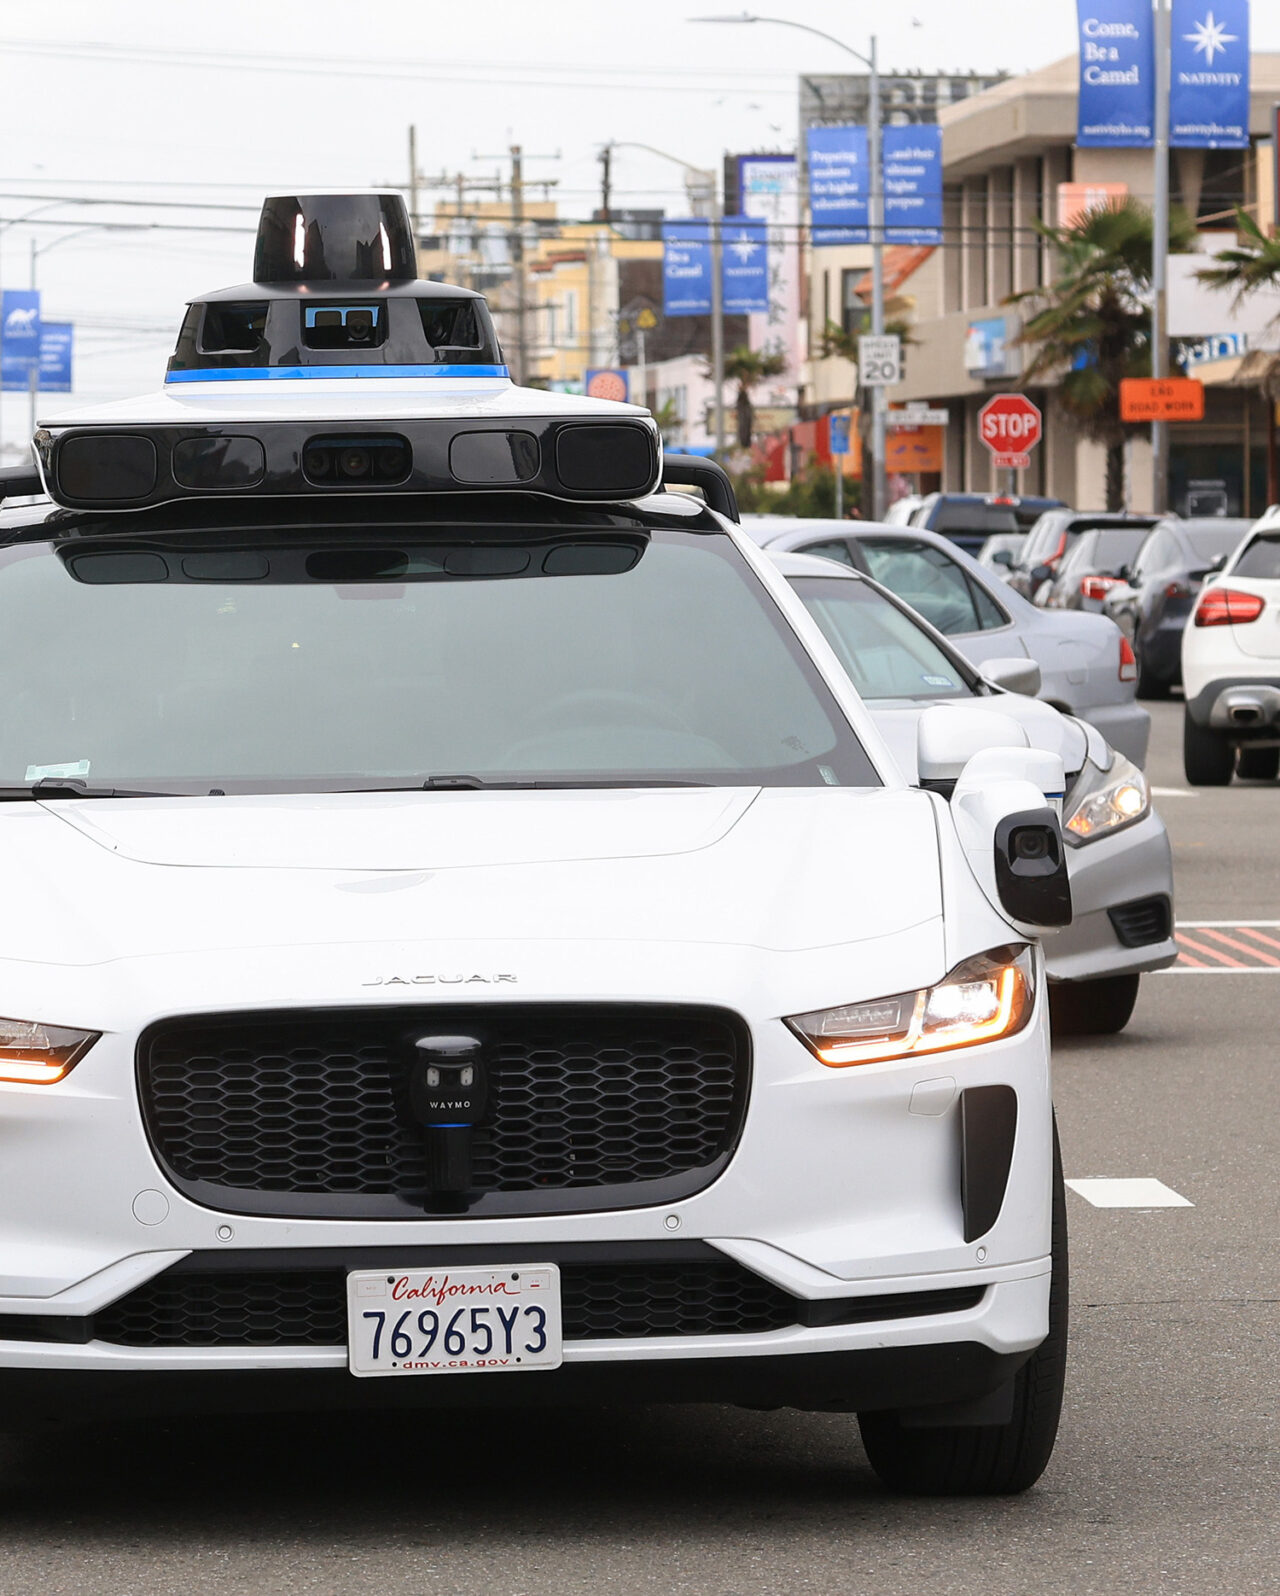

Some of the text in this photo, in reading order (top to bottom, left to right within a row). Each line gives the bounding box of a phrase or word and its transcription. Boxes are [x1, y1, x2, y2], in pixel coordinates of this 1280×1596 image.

[1082, 18, 1140, 40] Come,
[1084, 42, 1119, 61] Be a
[1083, 64, 1140, 85] Camel
[1178, 71, 1242, 86] NATIVITY
[864, 361, 896, 381] 20
[984, 413, 1037, 438] STOP
[361, 974, 519, 987] JAGUAR
[429, 1101, 471, 1109] WAYMO
[392, 1275, 520, 1306] California
[363, 1306, 547, 1360] 76965Y3
[402, 1358, 510, 1370] dmv.ca.gov
